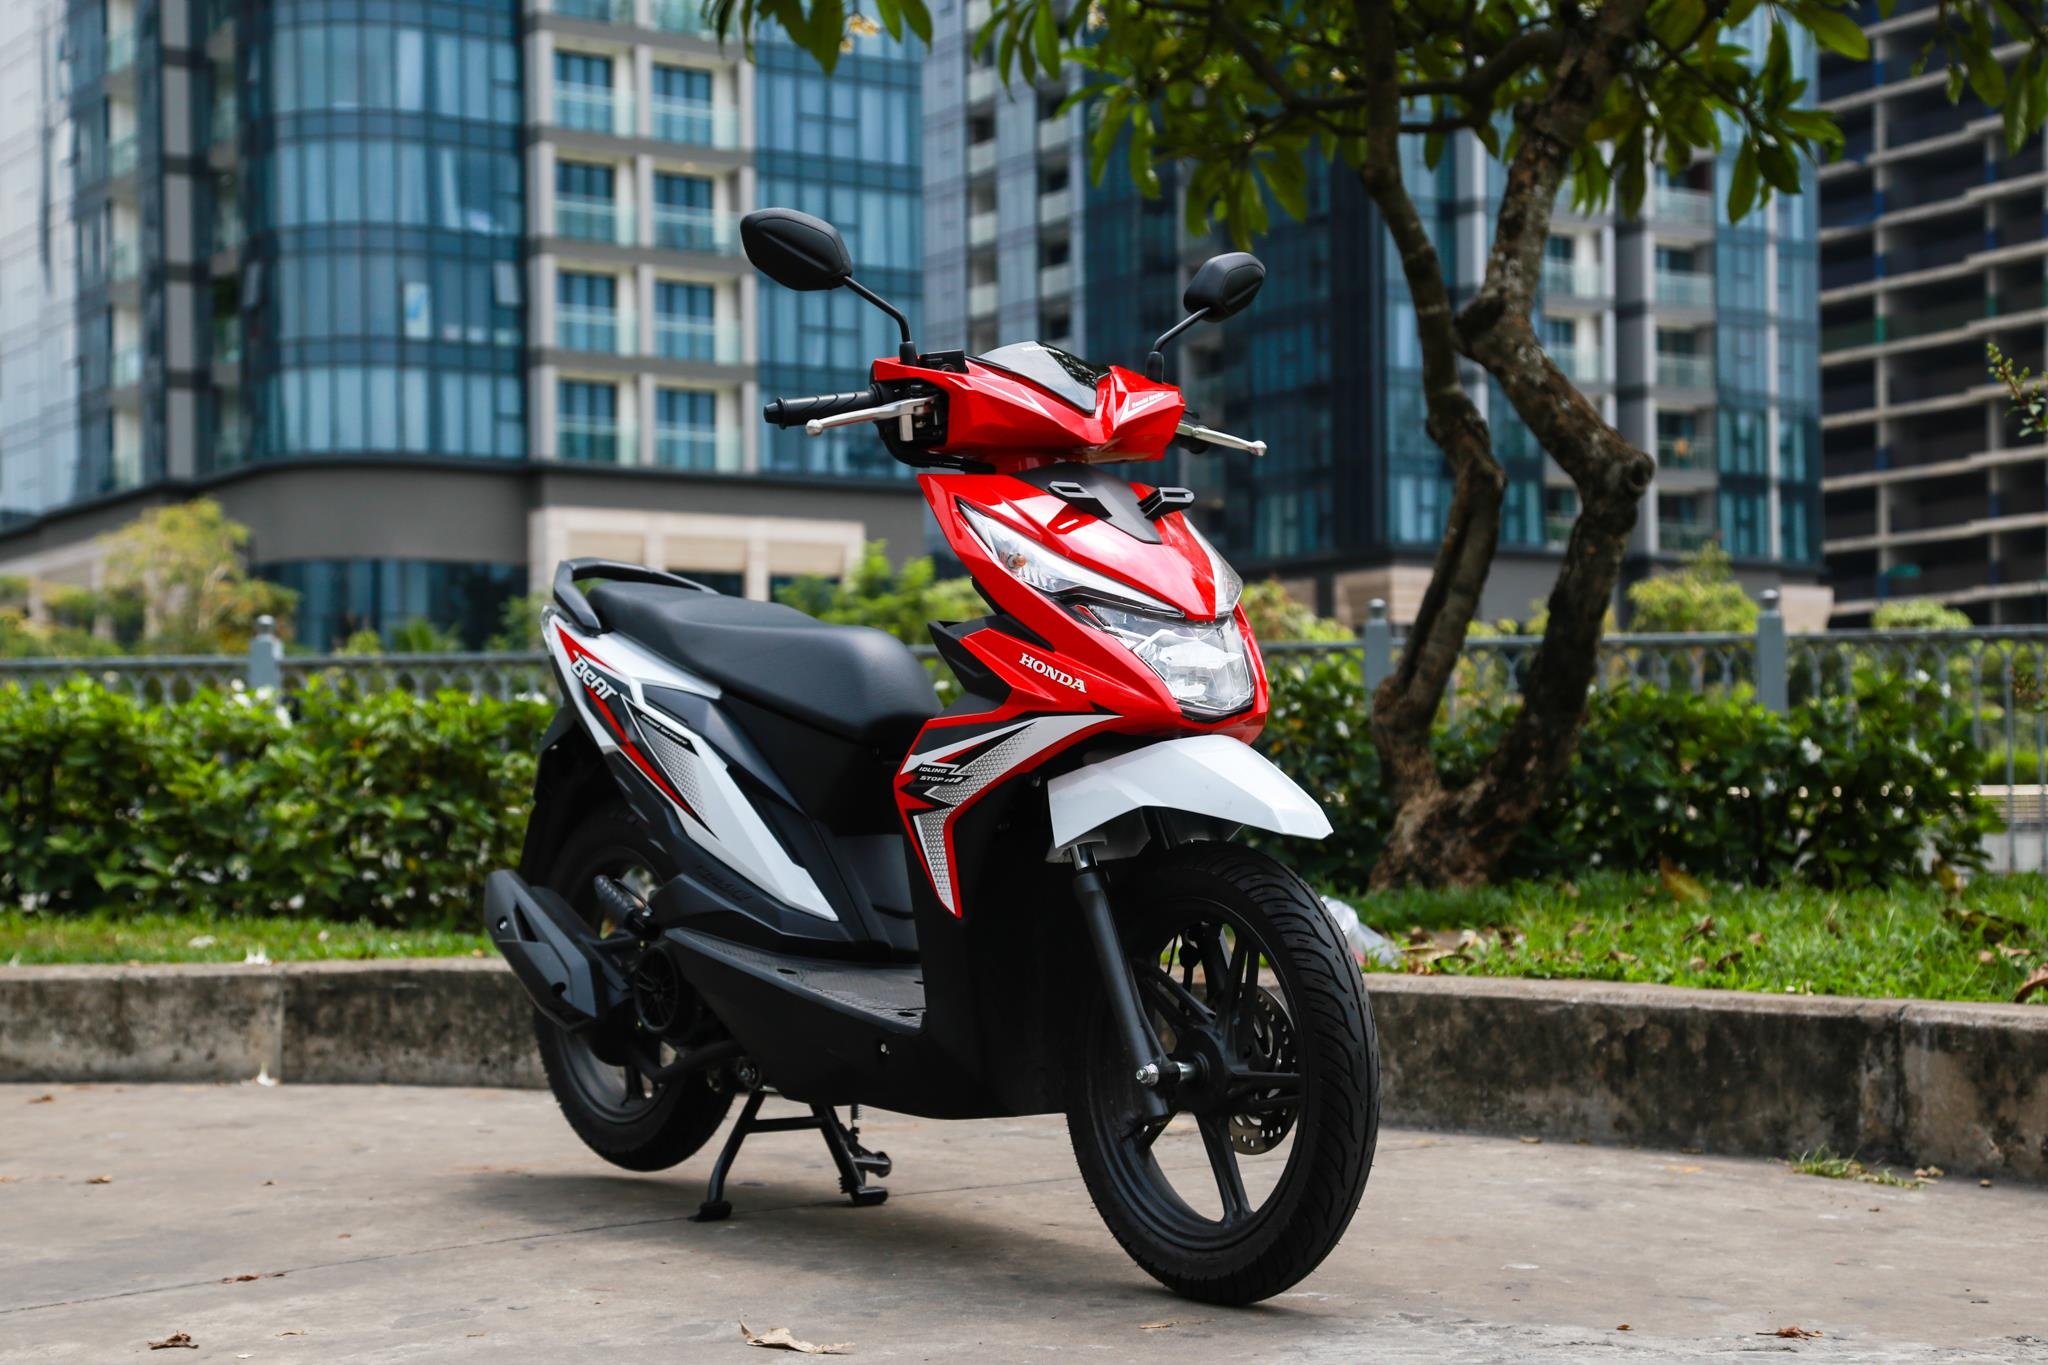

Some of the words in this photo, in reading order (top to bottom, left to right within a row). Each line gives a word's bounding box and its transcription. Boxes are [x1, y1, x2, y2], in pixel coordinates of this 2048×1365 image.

[571, 655, 618, 700] BeAT
[1018, 652, 1087, 694] HONDA
[918, 766, 948, 774] IDLING
